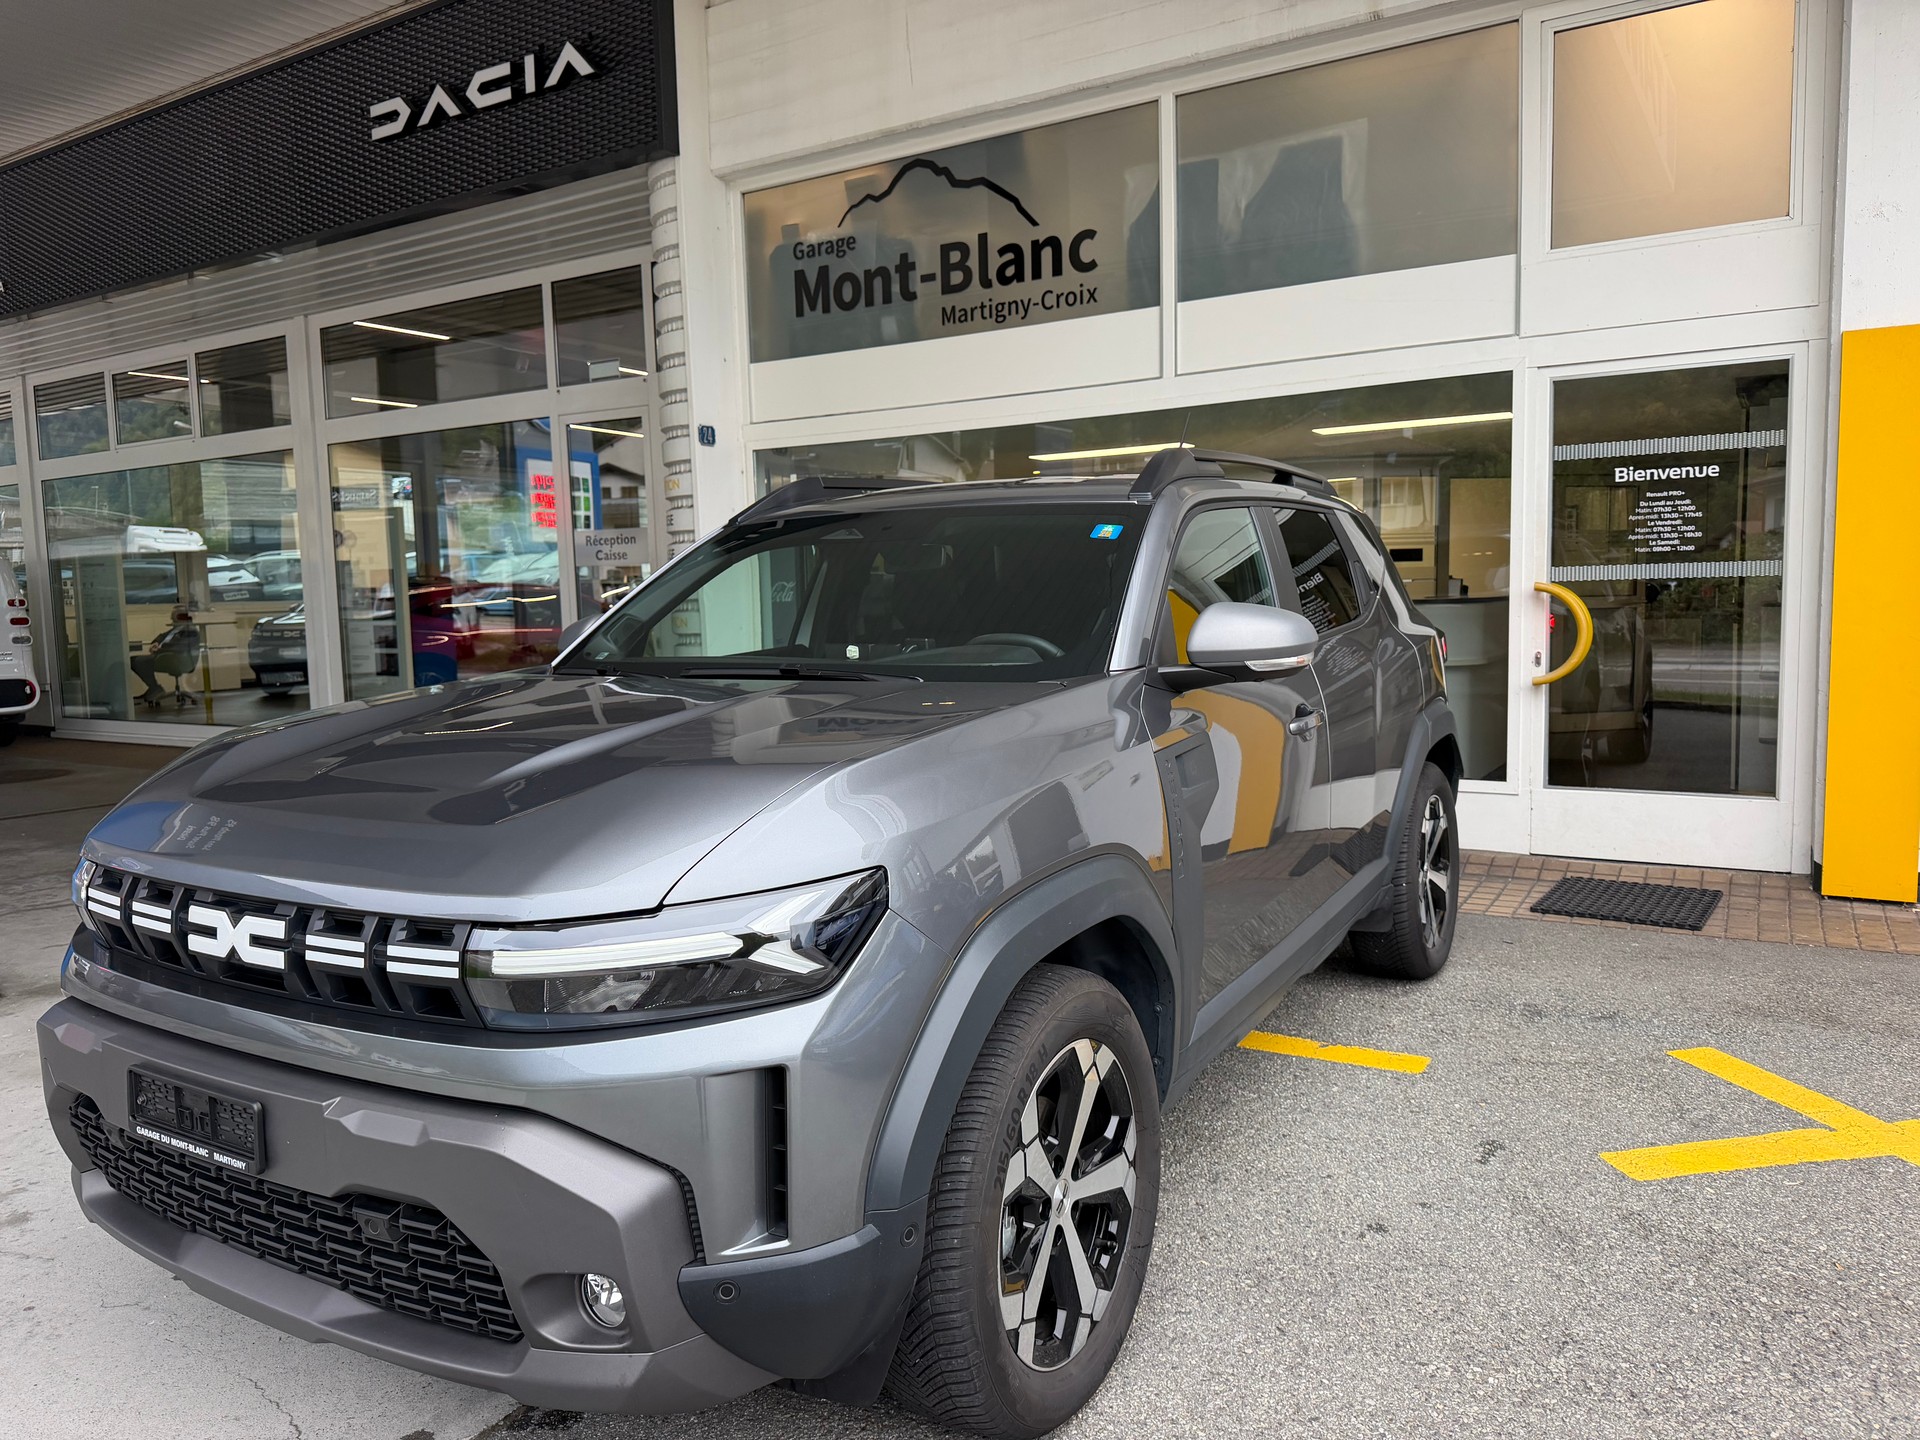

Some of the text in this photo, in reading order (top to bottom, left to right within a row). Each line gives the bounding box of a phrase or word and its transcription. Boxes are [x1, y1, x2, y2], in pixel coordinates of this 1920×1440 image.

[370, 41, 595, 141] DACIA
[793, 235, 856, 260] Garage
[794, 229, 1098, 318] Mont-Blanc
[941, 284, 1098, 326] Martigny-Croix
[702, 426, 713, 444] 24
[1614, 465, 1720, 482] Bienvenue
[585, 533, 636, 548] Réception
[595, 550, 628, 561] Caisse
[136, 1126, 247, 1171] GARAGE DU MONT-BLANC MARTIGNY
